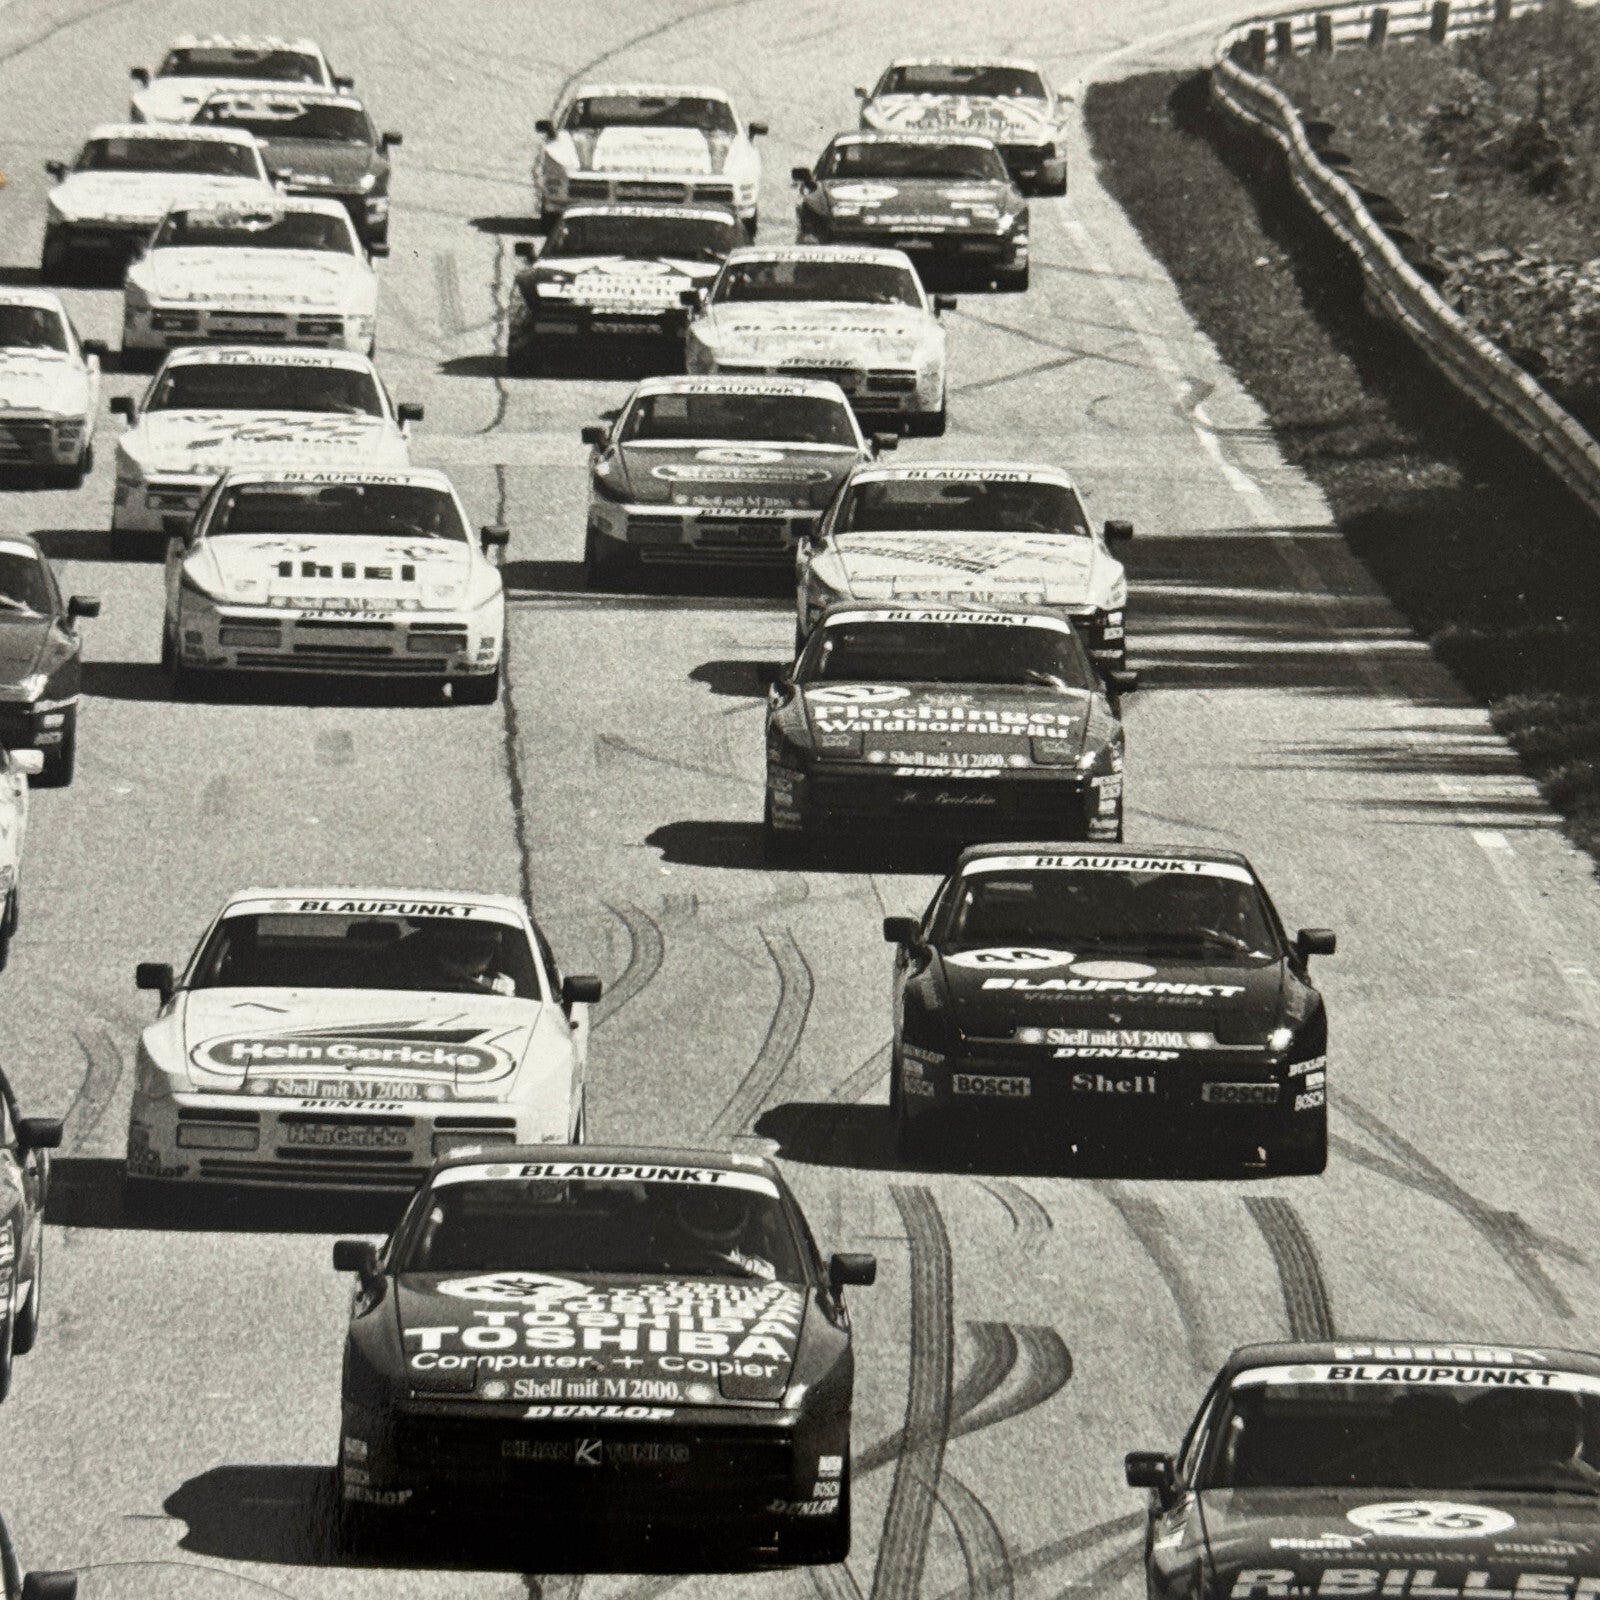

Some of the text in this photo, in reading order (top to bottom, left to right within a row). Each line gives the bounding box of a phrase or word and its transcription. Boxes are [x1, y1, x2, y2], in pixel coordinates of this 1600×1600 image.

[733, 325, 903, 335] BLAUPUNKT
[283, 473, 410, 484] BLAUPUNKT
[906, 471, 1030, 481] BLAUPUNKT
[887, 612, 1029, 625] BLAUPUNKT
[814, 705, 1080, 726] Plochinger
[816, 719, 1068, 739] Waldhornbräu
[895, 767, 1001, 778] DUNLOP
[1035, 857, 1207, 872] BLAUPUNKT
[299, 901, 477, 917] BLAUPUNKT
[981, 978, 1246, 997] BLAUPUNKT
[1047, 1028, 1088, 1046] Shell
[1091, 1029, 1119, 1047] mit
[1119, 1030, 1141, 1048] M
[231, 1042, 481, 1068] Hein Gericke
[1053, 1048, 1180, 1061] DUNLOP
[275, 1078, 318, 1096] Shell
[321, 1081, 350, 1098] mit
[354, 1082, 375, 1098] M
[957, 1076, 1024, 1095] BOSCH
[1072, 1073, 1156, 1094] Shell
[300, 1100, 404, 1111] DUNLOP
[287, 1125, 408, 1147] Hein Gericke
[519, 1164, 728, 1184] BLAUPUNKT
[473, 1310, 797, 1339] TOSHIBA
[404, 1326, 790, 1359] TOSHIBA
[411, 1352, 593, 1371] Computer
[659, 1355, 779, 1379] Copier
[1327, 1366, 1560, 1387] BLAUPUNKT
[513, 1378, 685, 1401] Shell mit M 2000.
[524, 1406, 676, 1420] DUNLOP
[575, 1438, 602, 1465] K
[1376, 1508, 1488, 1529] 25
